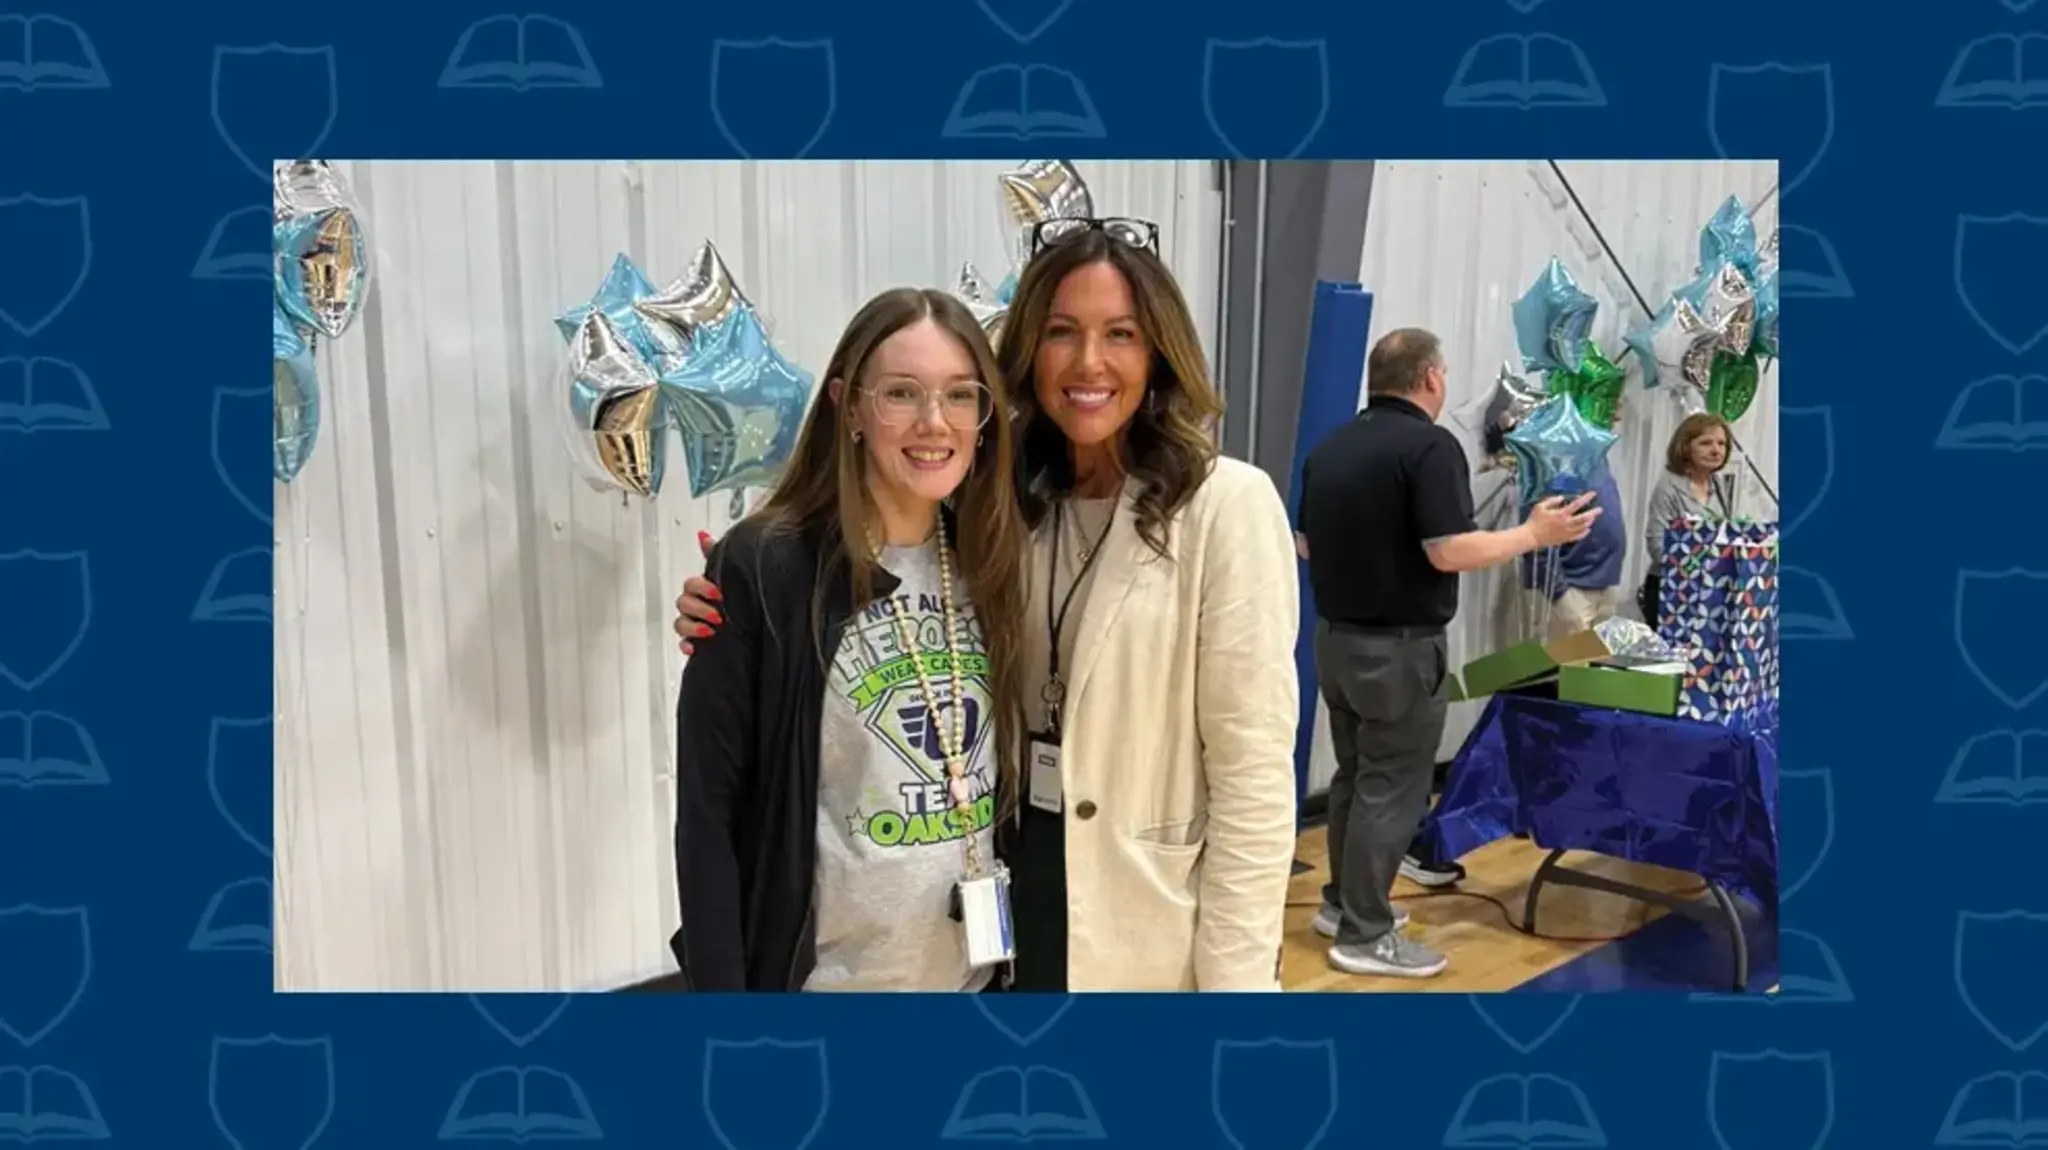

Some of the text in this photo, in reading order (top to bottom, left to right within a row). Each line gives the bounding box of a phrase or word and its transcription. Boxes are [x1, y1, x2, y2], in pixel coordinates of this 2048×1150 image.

[863, 594, 910, 624] NOT
[879, 657, 983, 683] WEA CAES
[899, 766, 993, 815] TEM
[868, 794, 995, 847] OAKSID
